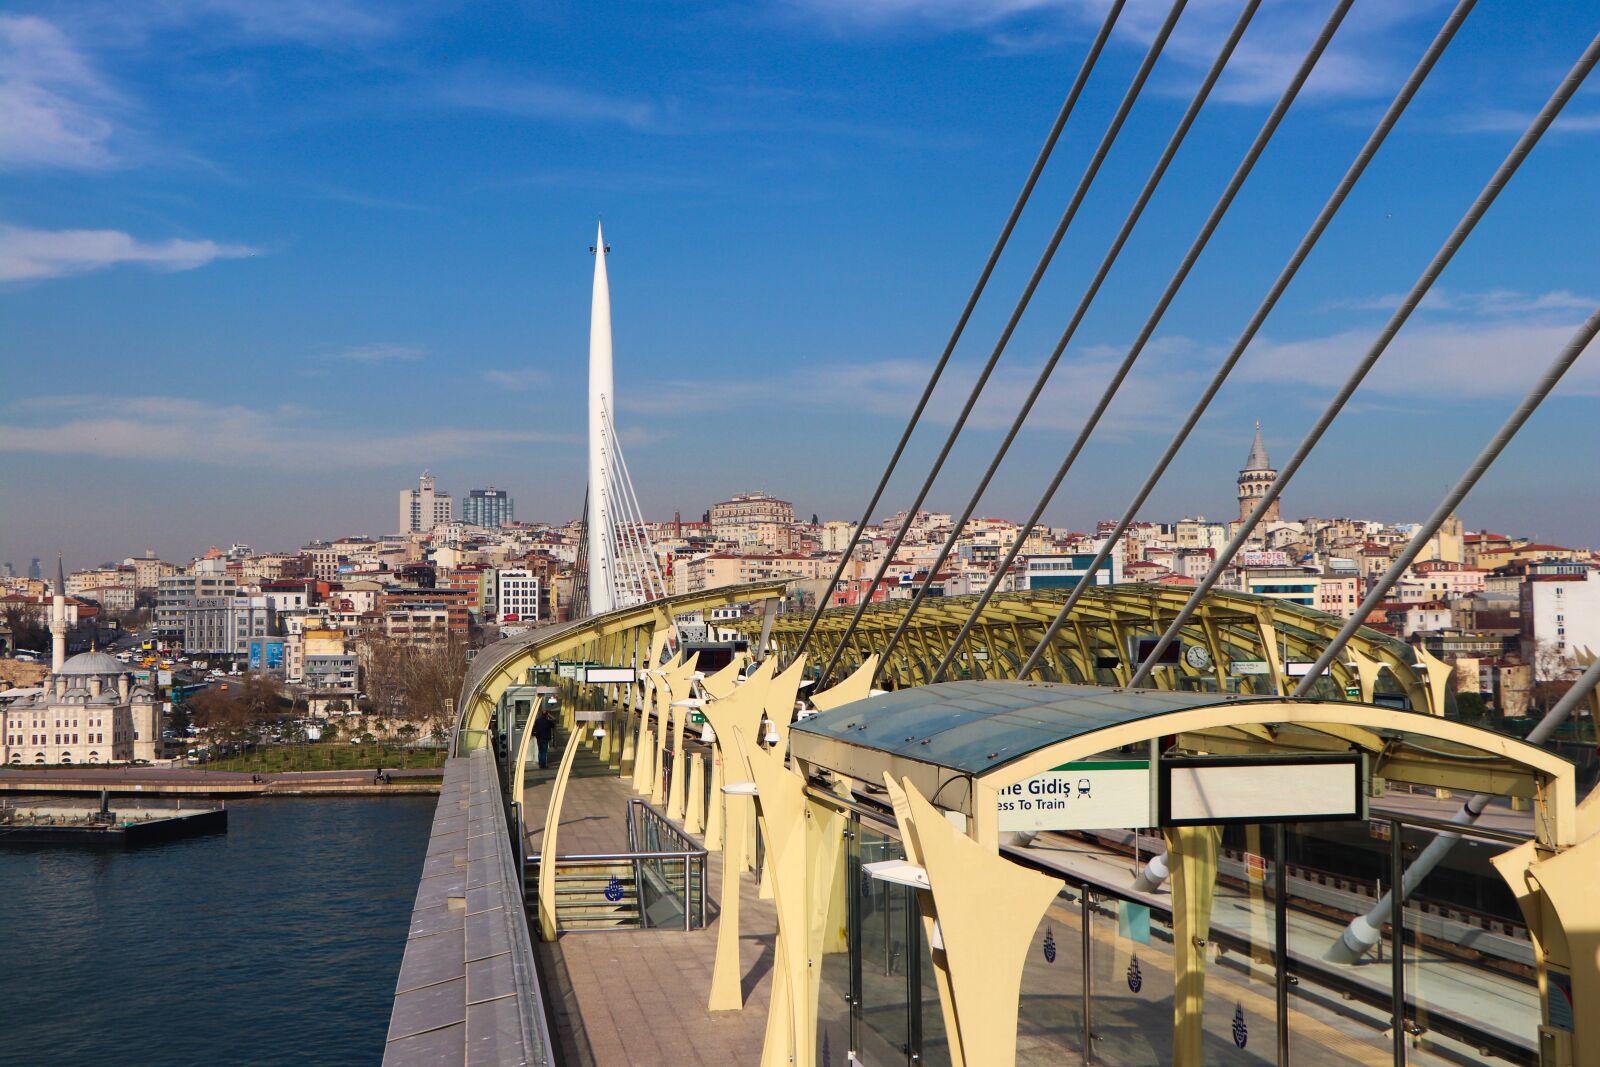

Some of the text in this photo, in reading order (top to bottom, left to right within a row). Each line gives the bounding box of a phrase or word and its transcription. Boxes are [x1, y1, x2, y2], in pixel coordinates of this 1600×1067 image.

[1028, 779, 1071, 798] Gidiş
[1018, 799, 1032, 810] To
[1035, 798, 1065, 810] Train
